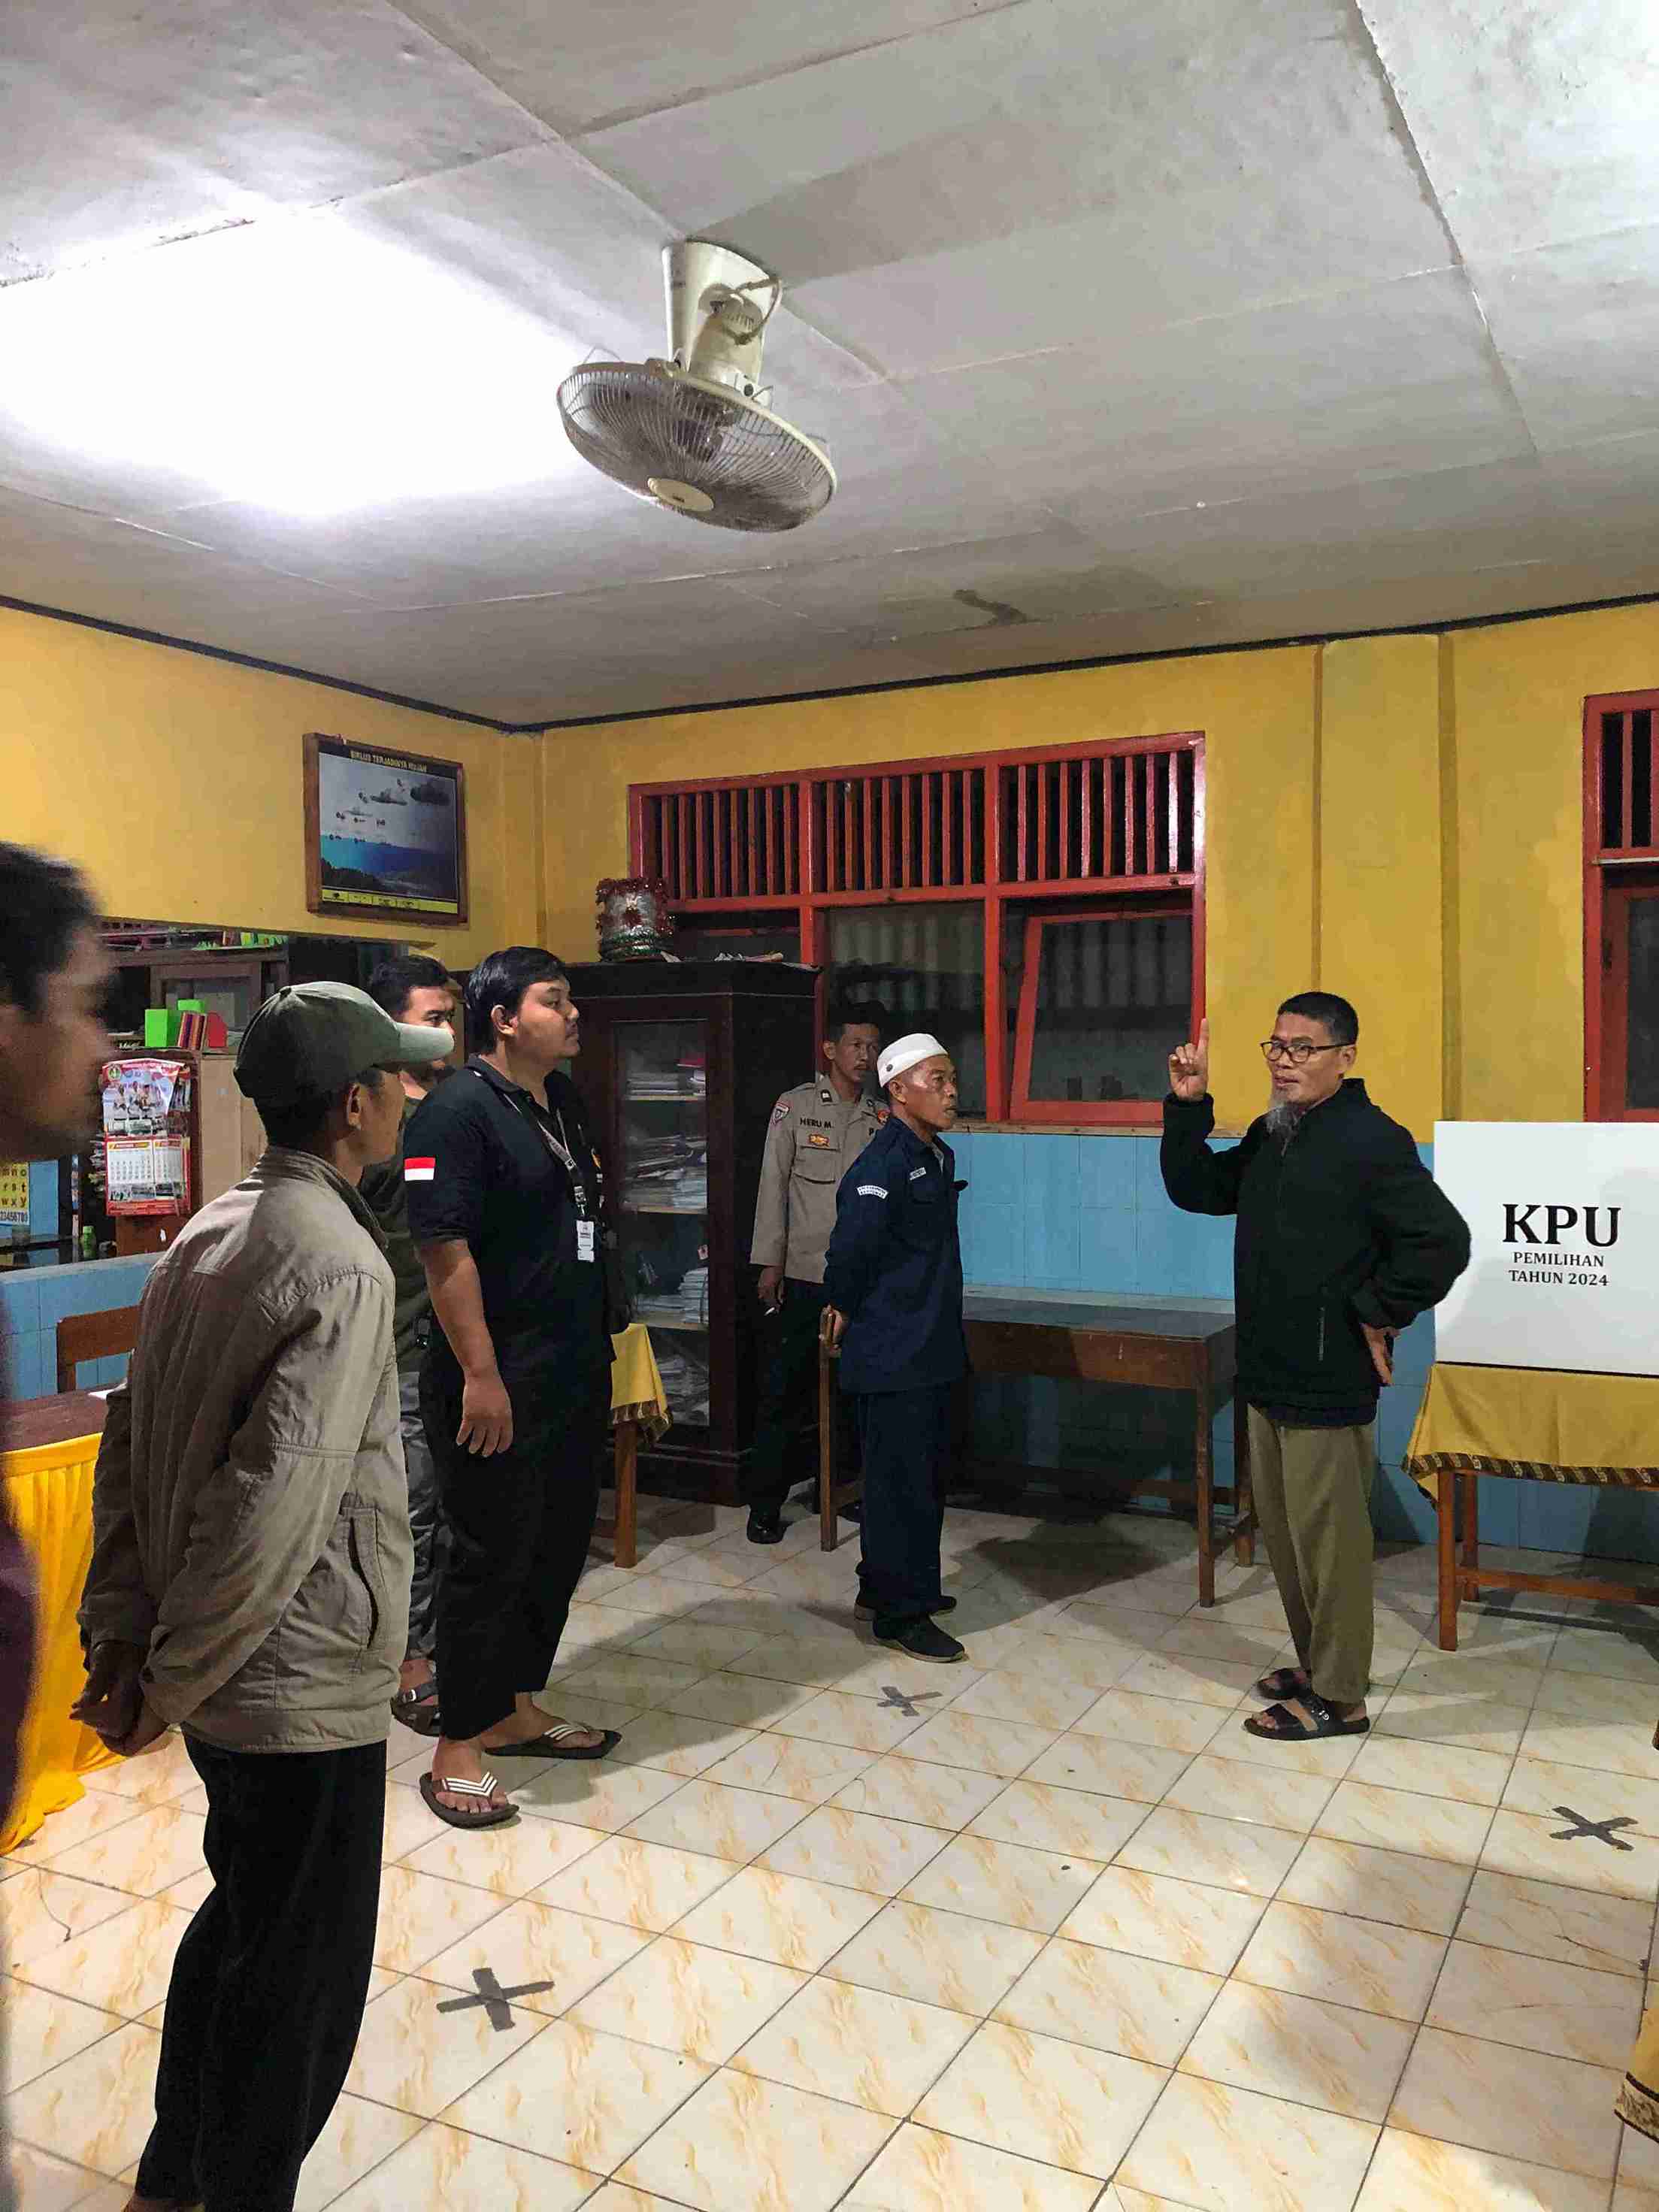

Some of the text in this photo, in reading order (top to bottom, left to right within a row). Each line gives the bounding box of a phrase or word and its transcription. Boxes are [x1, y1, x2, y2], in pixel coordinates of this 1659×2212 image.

[800, 1118, 822, 1127] HERU
[20, 1197, 26, 1208] y
[1503, 1204, 1621, 1247] KPU
[1513, 1251, 1604, 1267] PEMILIHAN
[1509, 1269, 1609, 1286] TAHUN 2024
